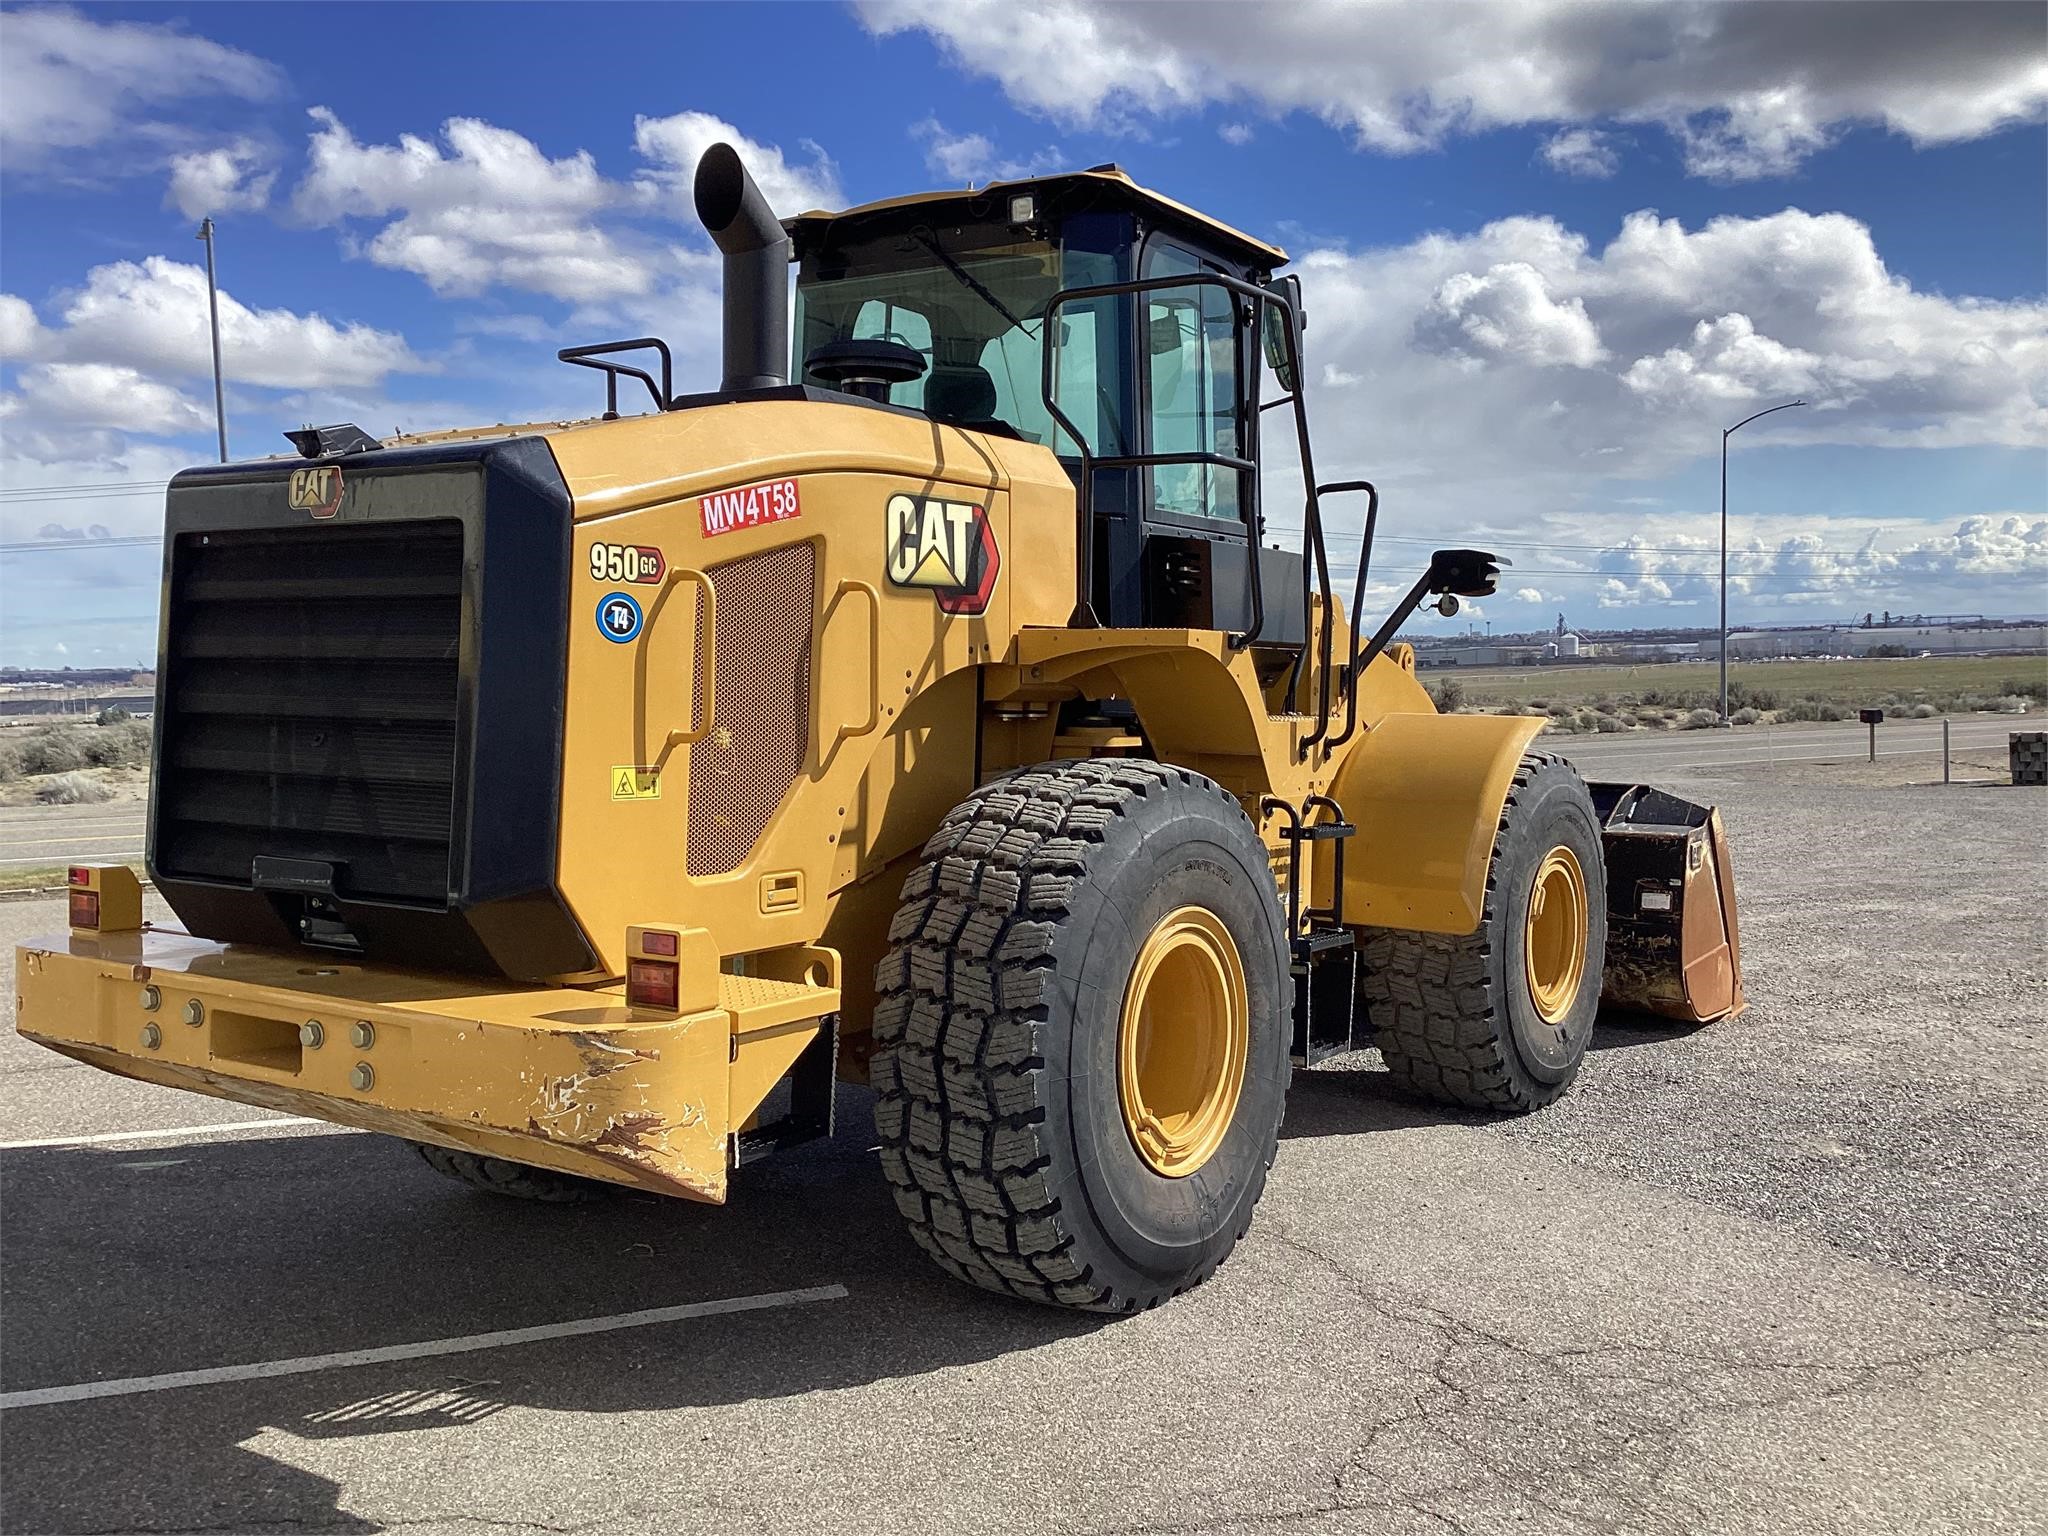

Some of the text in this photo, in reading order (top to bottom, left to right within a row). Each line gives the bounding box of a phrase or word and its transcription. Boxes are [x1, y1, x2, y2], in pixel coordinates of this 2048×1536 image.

[291, 469, 333, 507] CAT
[703, 481, 797, 532] MW4T58
[888, 495, 973, 587] CAT
[591, 543, 657, 582] 950 GC
[611, 605, 629, 630] T4
